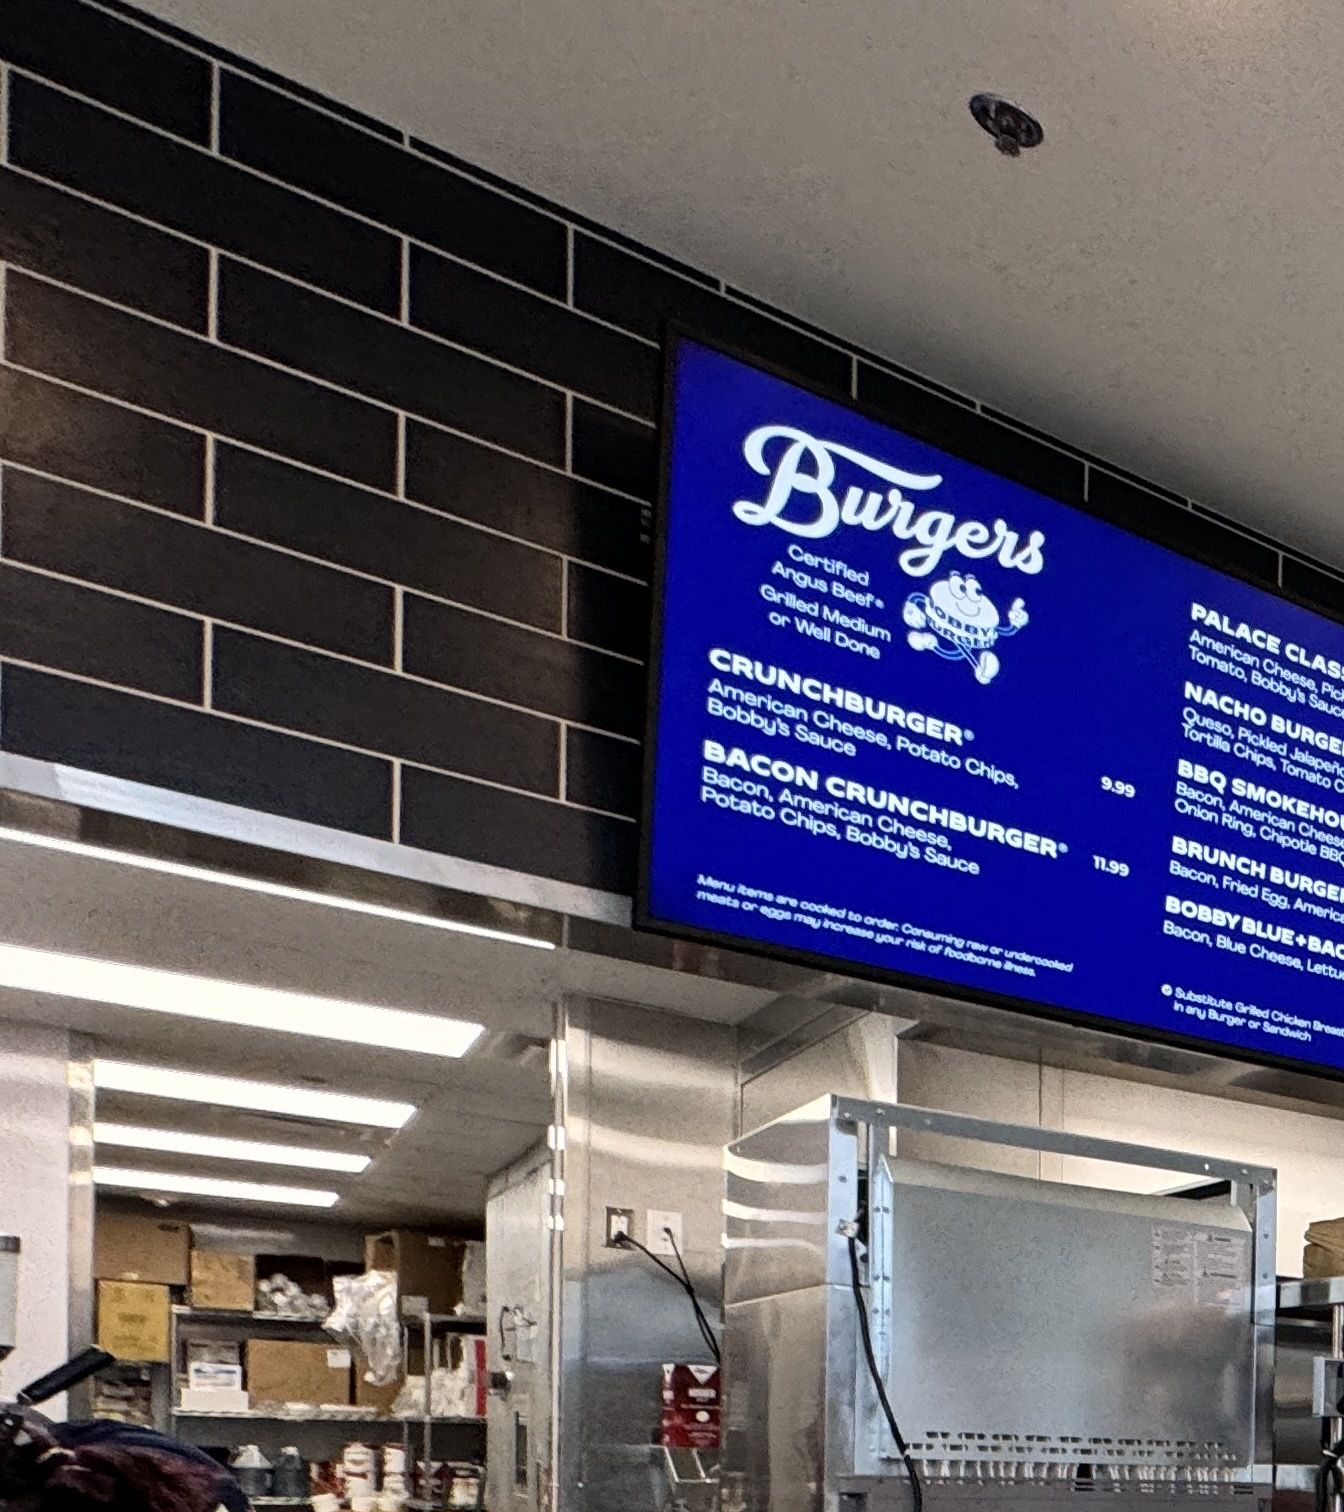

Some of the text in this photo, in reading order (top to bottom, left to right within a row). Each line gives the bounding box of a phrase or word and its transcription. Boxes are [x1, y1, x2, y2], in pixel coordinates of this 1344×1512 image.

[732, 425, 1045, 577] Burgers
[771, 560, 829, 593] Angus
[787, 544, 870, 587] Certified
[760, 583, 892, 643] Grilled Medium
[768, 611, 881, 660] or Well Done
[1190, 602, 1282, 655] PALACE
[1188, 644, 1251, 683] Tomato,
[1249, 667, 1308, 704] Bobby's
[1189, 629, 1260, 669] American
[1262, 658, 1319, 694] Cheese,
[707, 697, 857, 757] Bobby's Sauce
[1184, 680, 1267, 726] NACHO
[707, 678, 1019, 790] American Cheese, Potato Chips,
[1181, 706, 1235, 740] Queso,
[1236, 726, 1288, 757] Pickled
[1181, 722, 1233, 753] Tortilla
[1231, 740, 1280, 772] Chips,
[1278, 756, 1332, 789] Tomato
[703, 739, 819, 791] BACON
[1101, 776, 1136, 798] 9.99
[1177, 758, 1227, 795] BBQ
[701, 786, 980, 875] Potato Chips, Bobby's Sauce
[702, 766, 952, 852] Bacon, American Cheese,
[1174, 798, 1219, 824] Onion
[1221, 812, 1257, 839] Ring,
[1259, 825, 1318, 856] Chipotle
[1175, 780, 1226, 812] Bacon,
[1228, 799, 1296, 833] American
[1093, 855, 1130, 877] 11.99
[1171, 835, 1267, 880] BRUNCH
[1169, 859, 1219, 889] Bacon,
[1222, 875, 1259, 899] Fried
[1260, 886, 1291, 910] Egg,
[1162, 919, 1213, 948] Bacon,
[1215, 933, 1247, 955] Blue
[1249, 943, 1304, 972] Cheese,
[1165, 895, 1241, 930] BOBBY
[1241, 916, 1295, 946] BLUE
